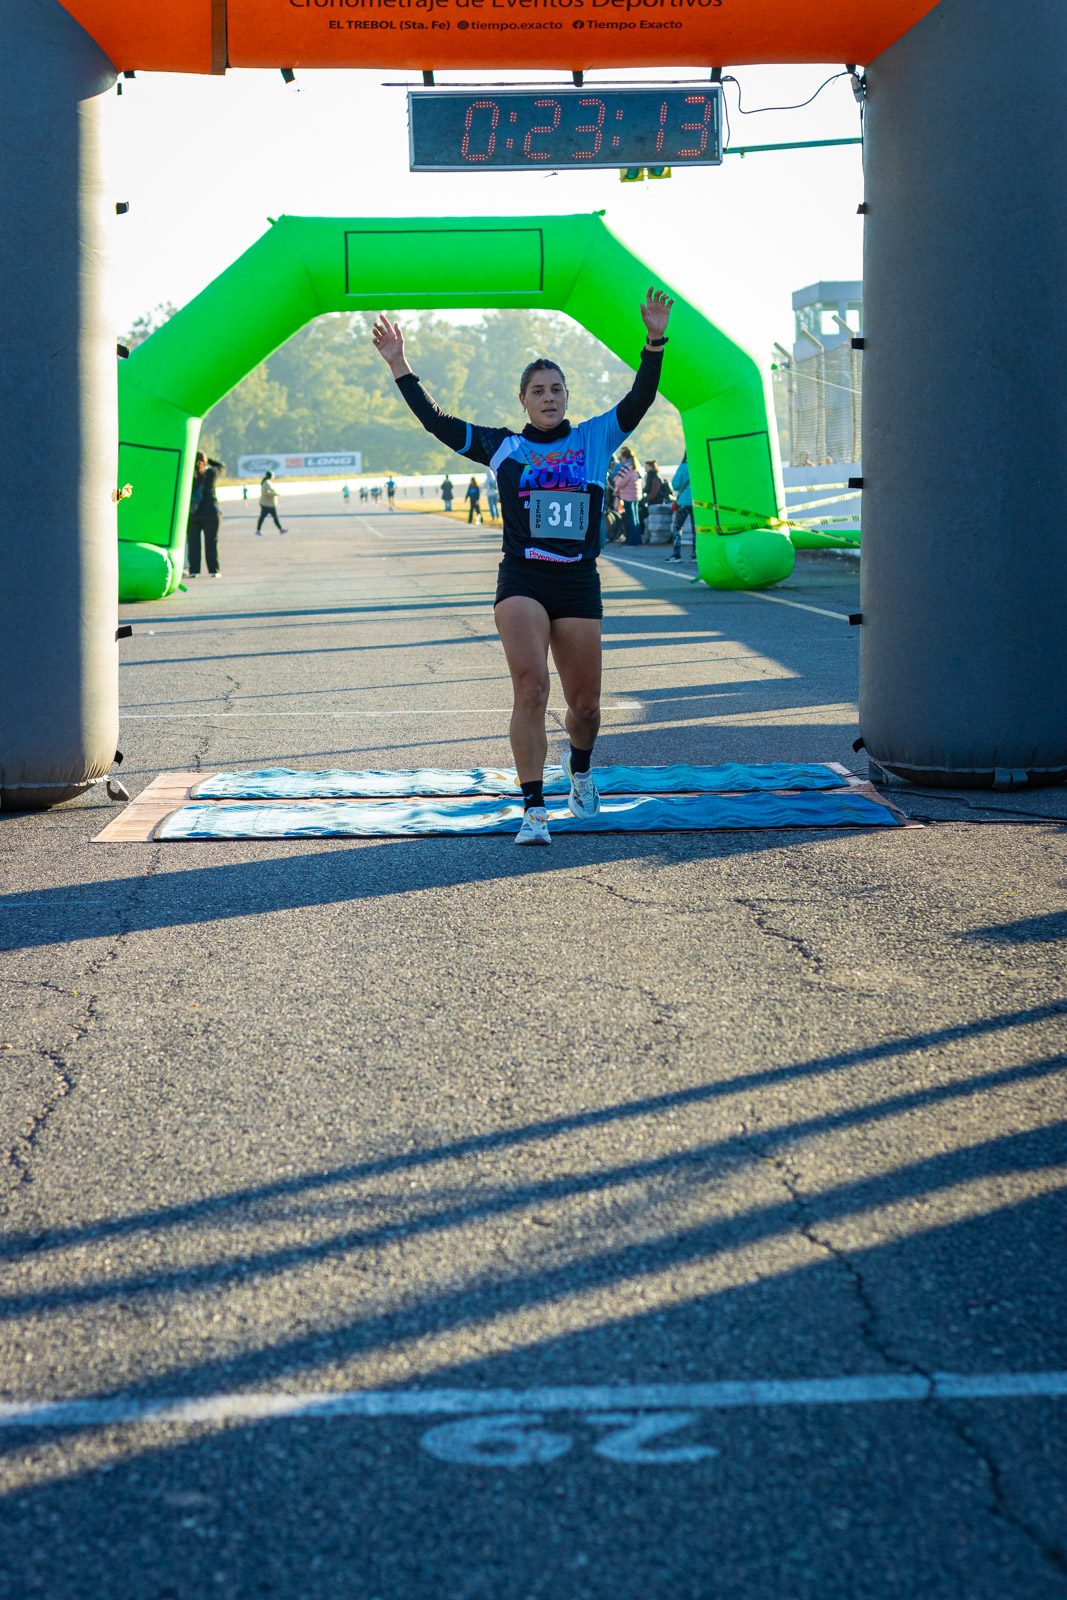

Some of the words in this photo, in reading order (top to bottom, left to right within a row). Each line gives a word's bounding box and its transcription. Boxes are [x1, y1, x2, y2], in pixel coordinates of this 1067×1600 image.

[328, 20, 344, 29] EL
[346, 20, 397, 29] TREBOL
[400, 20, 429, 31] (Sta.
[431, 20, 451, 31] Fe)
[471, 20, 563, 31] tiempo.exacto
[587, 20, 637, 31] Tiempo
[640, 20, 683, 29] Exacto
[461, 96, 711, 161] 0:23:13
[307, 456, 353, 466] LONG
[518, 465, 582, 488] RUN
[548, 501, 573, 527] 31
